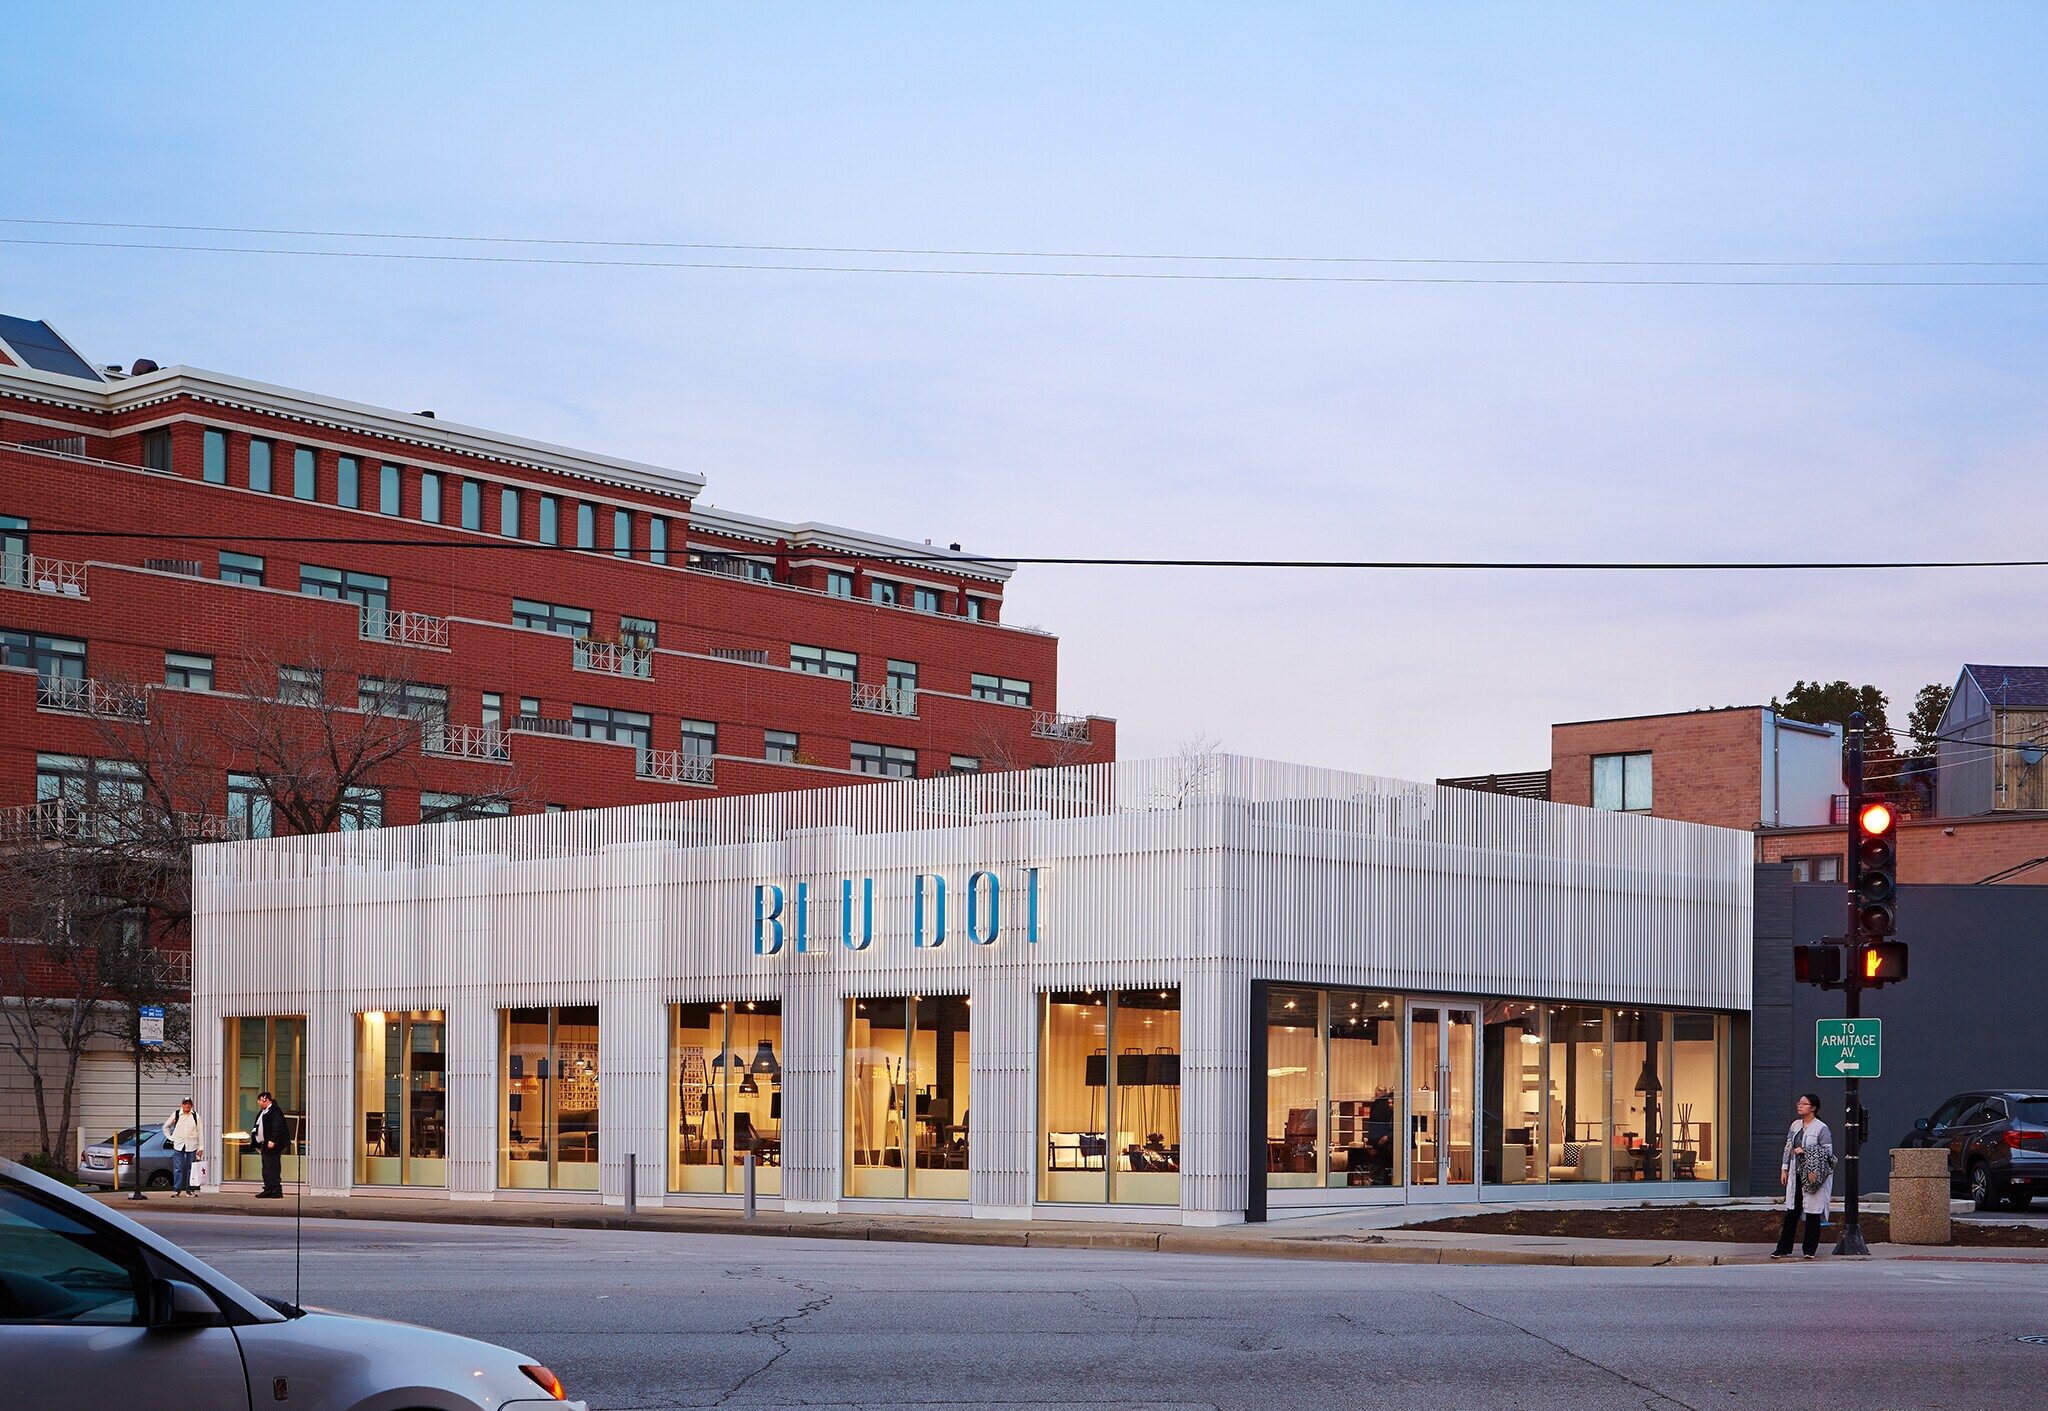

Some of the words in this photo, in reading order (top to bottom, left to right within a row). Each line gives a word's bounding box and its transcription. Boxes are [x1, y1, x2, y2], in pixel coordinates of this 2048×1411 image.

[755, 878, 873, 955] BLU
[915, 866, 1052, 947] DOT
[1841, 1023, 1855, 1034] TO
[1821, 1035, 1876, 1046] ARMITAGE
[1840, 1047, 1856, 1058] AV.
